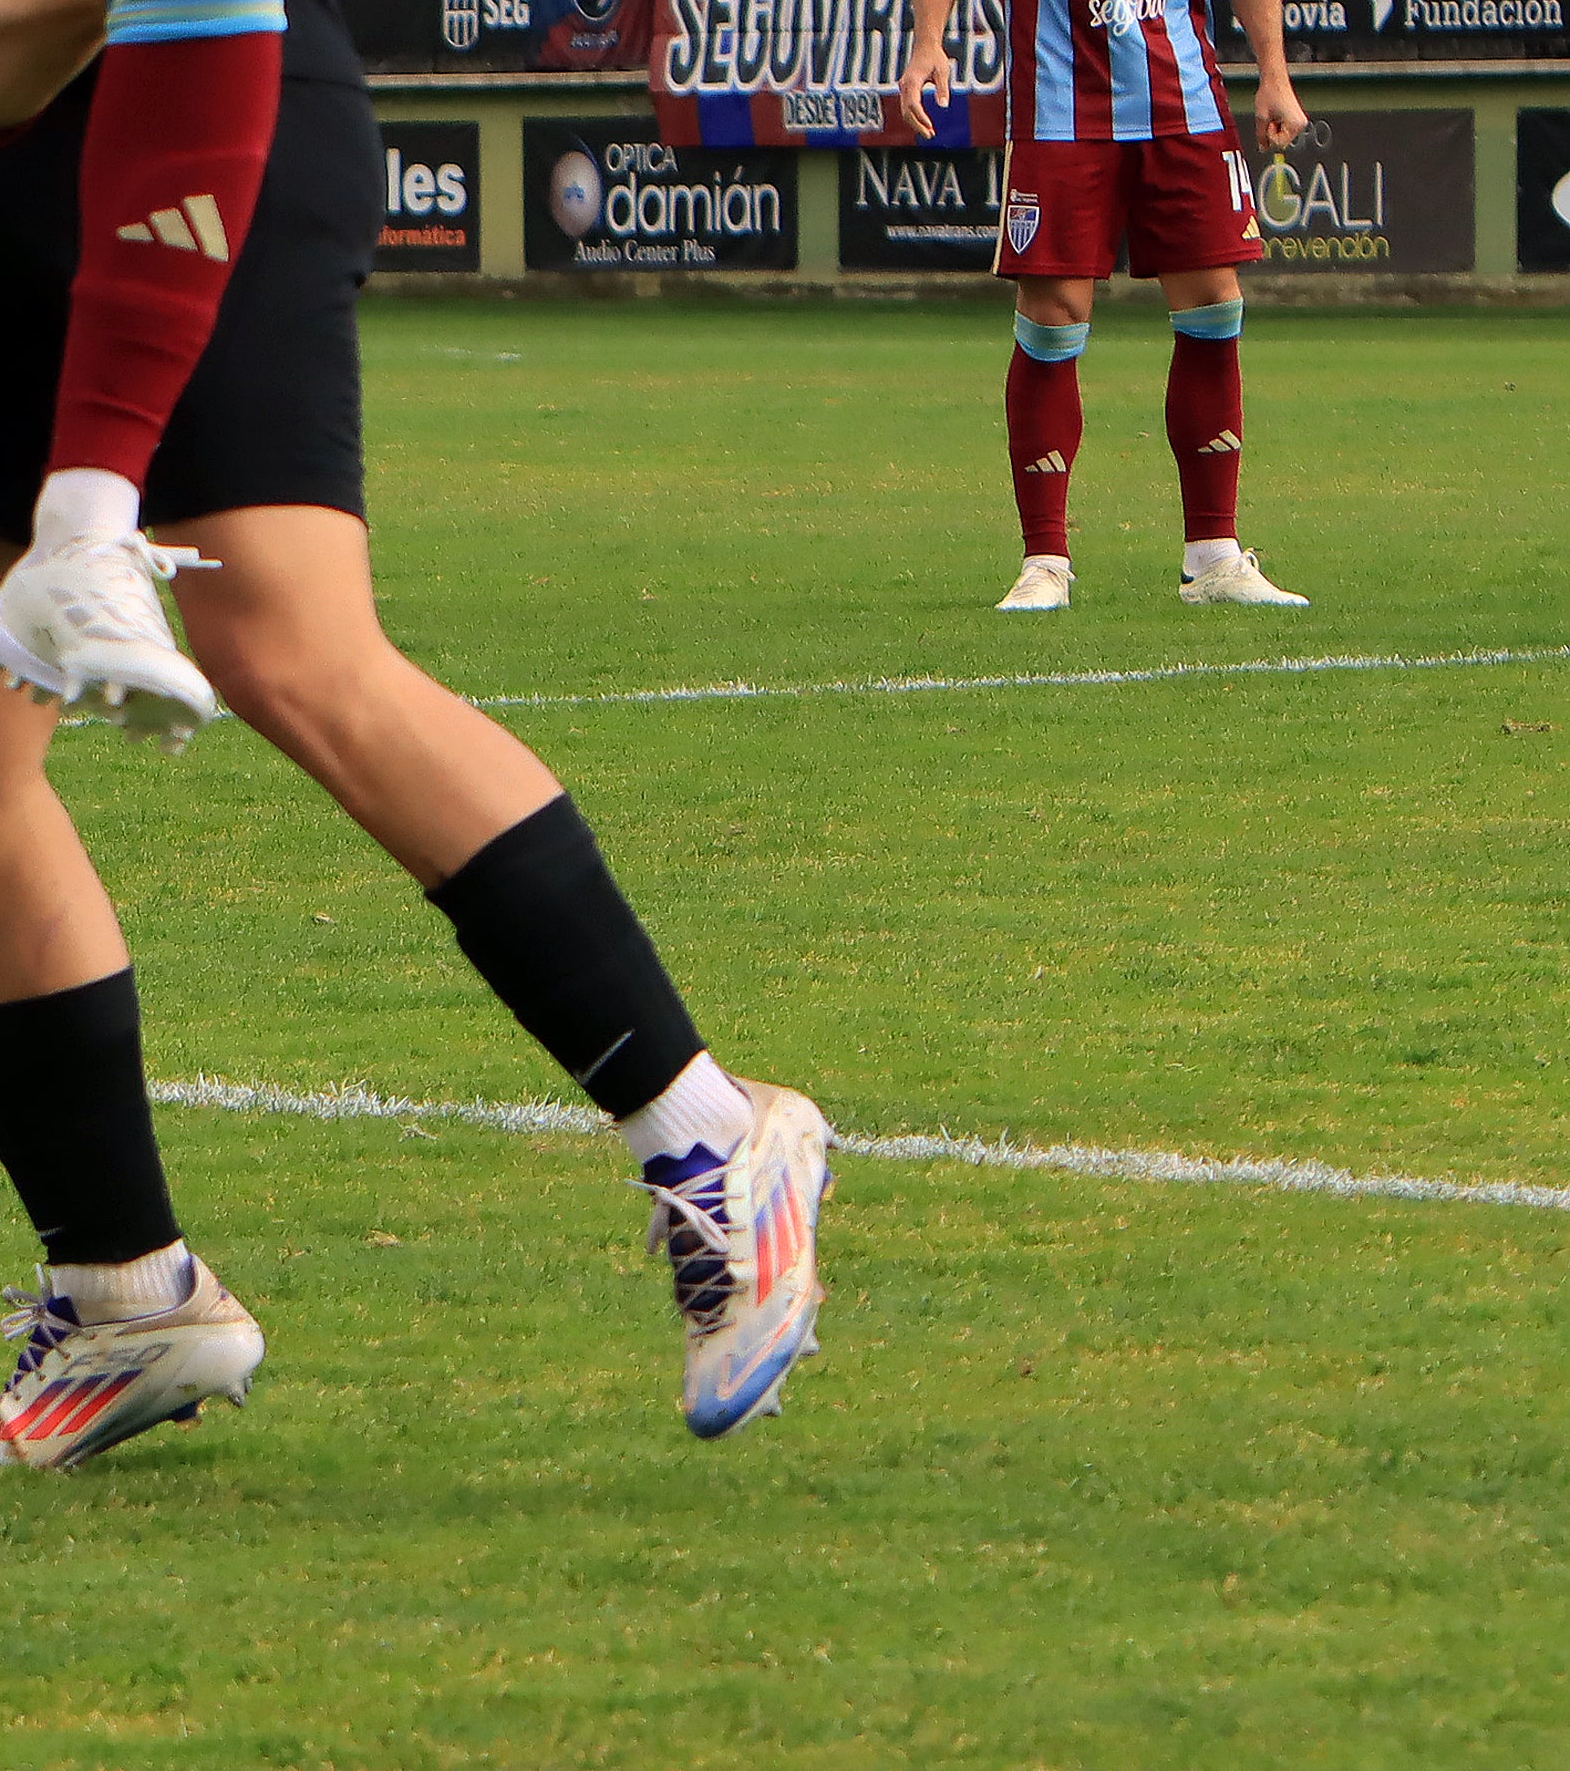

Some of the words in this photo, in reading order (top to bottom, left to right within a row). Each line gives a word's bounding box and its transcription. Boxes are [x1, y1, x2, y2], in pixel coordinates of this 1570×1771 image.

[784, 91, 836, 128] DESDE
[841, 90, 883, 128] 1994
[605, 165, 781, 234] damián
[855, 147, 967, 207] NAVA
[1258, 160, 1384, 229] GALI
[574, 239, 622, 262] Audio
[624, 239, 679, 262] Center
[683, 238, 717, 262] Plus
